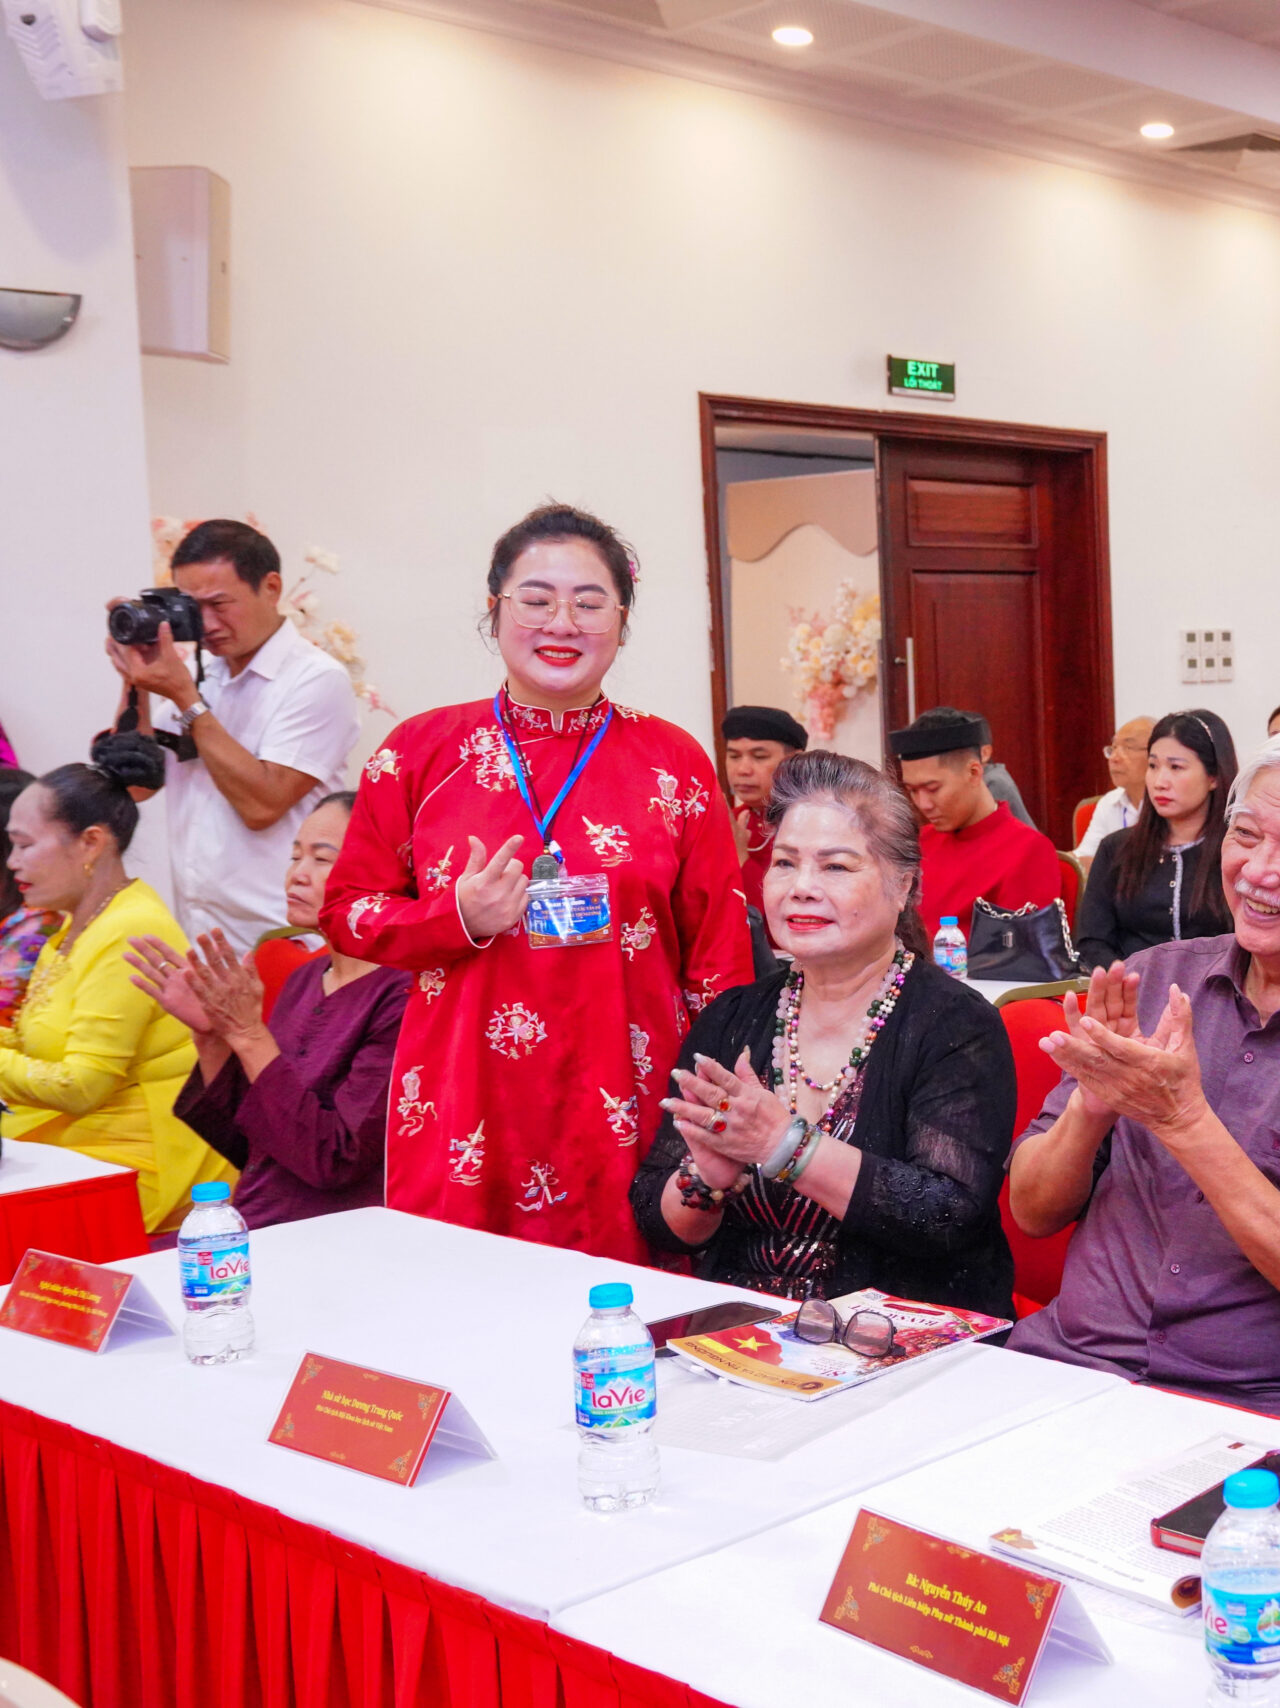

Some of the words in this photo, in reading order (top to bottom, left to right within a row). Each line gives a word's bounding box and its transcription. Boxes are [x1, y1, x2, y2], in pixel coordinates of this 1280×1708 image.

[907, 361, 939, 378] EXIT
[592, 1386, 644, 1408] laVie
[371, 1404, 388, 1419] Trung
[388, 1409, 404, 1421] Quốc
[919, 1577, 951, 1601] Nguyễn
[973, 1600, 988, 1615] An
